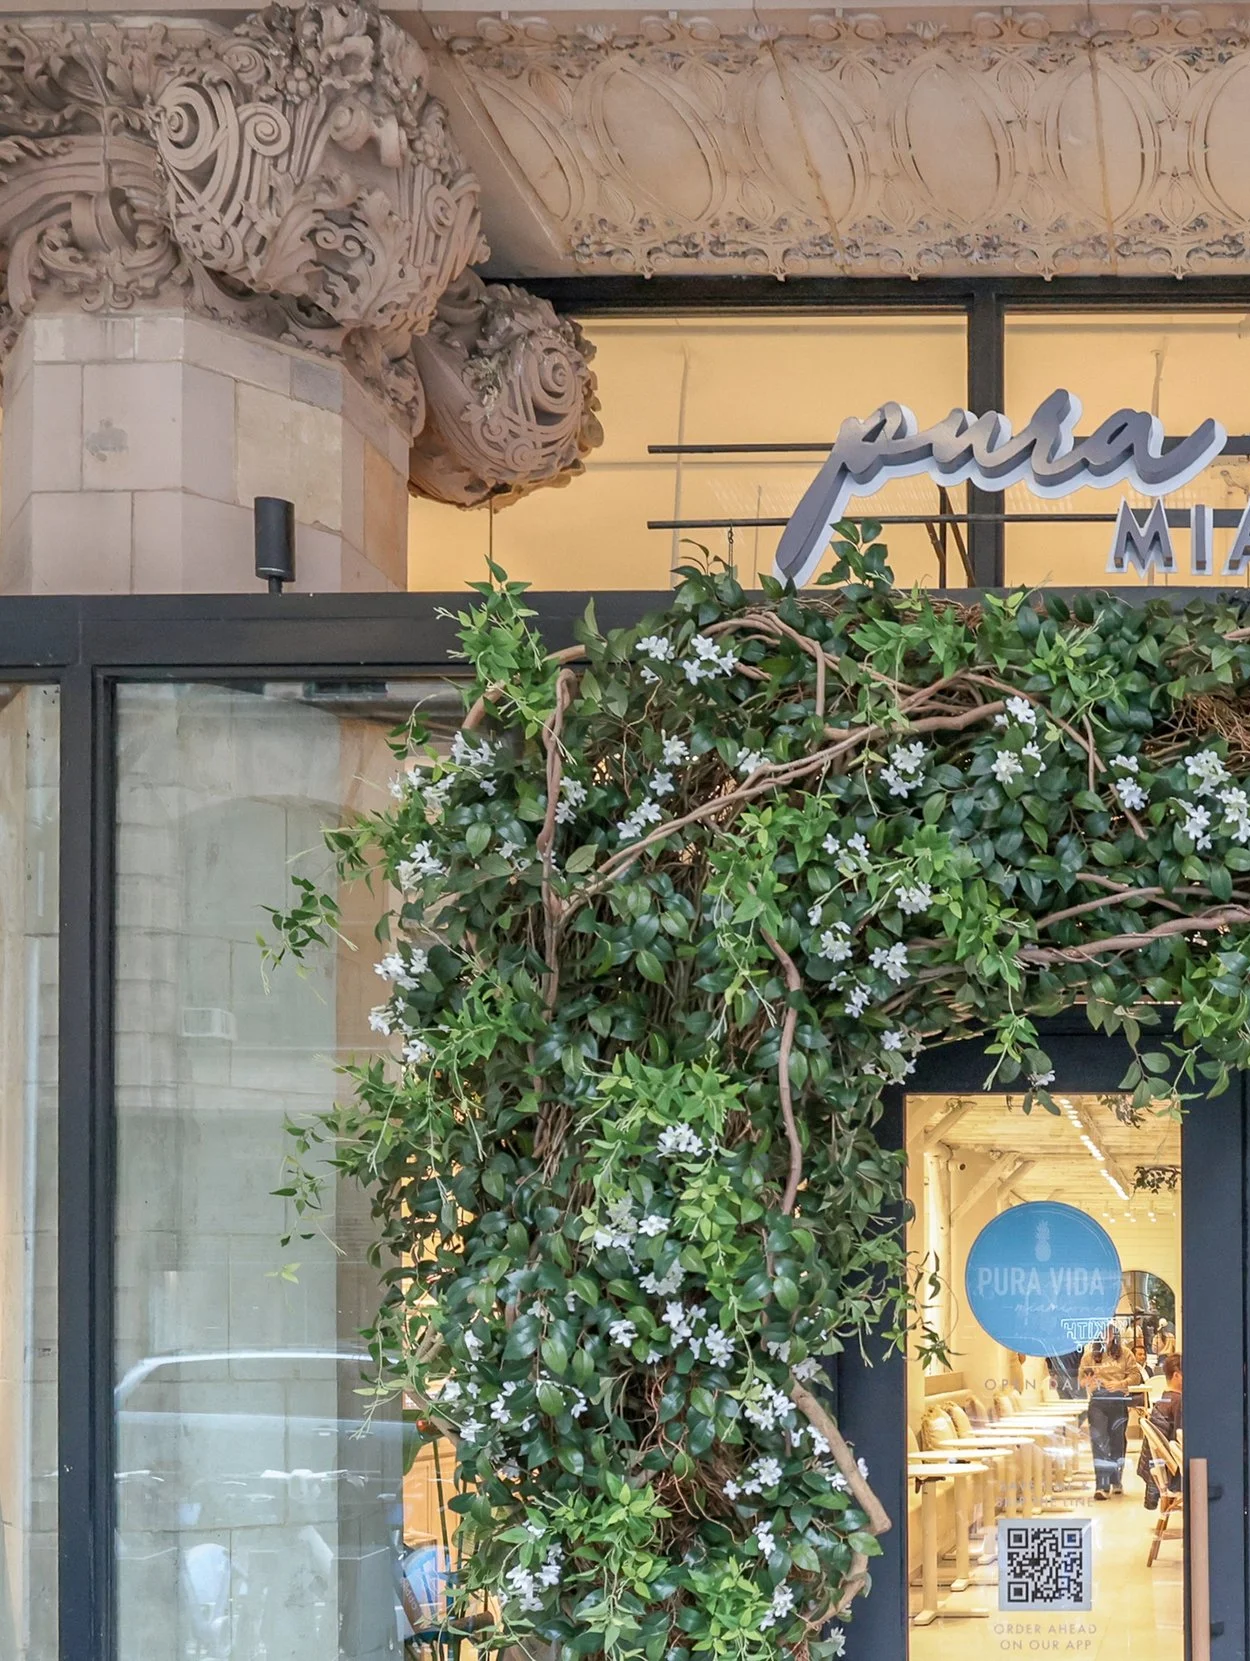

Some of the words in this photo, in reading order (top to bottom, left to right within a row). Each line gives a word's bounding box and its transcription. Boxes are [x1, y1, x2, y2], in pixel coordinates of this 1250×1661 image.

[978, 1267, 1041, 1296] PURA
[1053, 1267, 1105, 1296] VIDA
[984, 1378, 1036, 1391] OPN
[1048, 1379, 1103, 1391] DAIY
[1063, 1497, 1093, 1507] LINE
[993, 1623, 1041, 1634] ORDER
[1047, 1623, 1097, 1634] AHEAD
[1000, 1639, 1023, 1650] ON
[1029, 1639, 1059, 1650] OUR
[1065, 1639, 1092, 1650] APP
